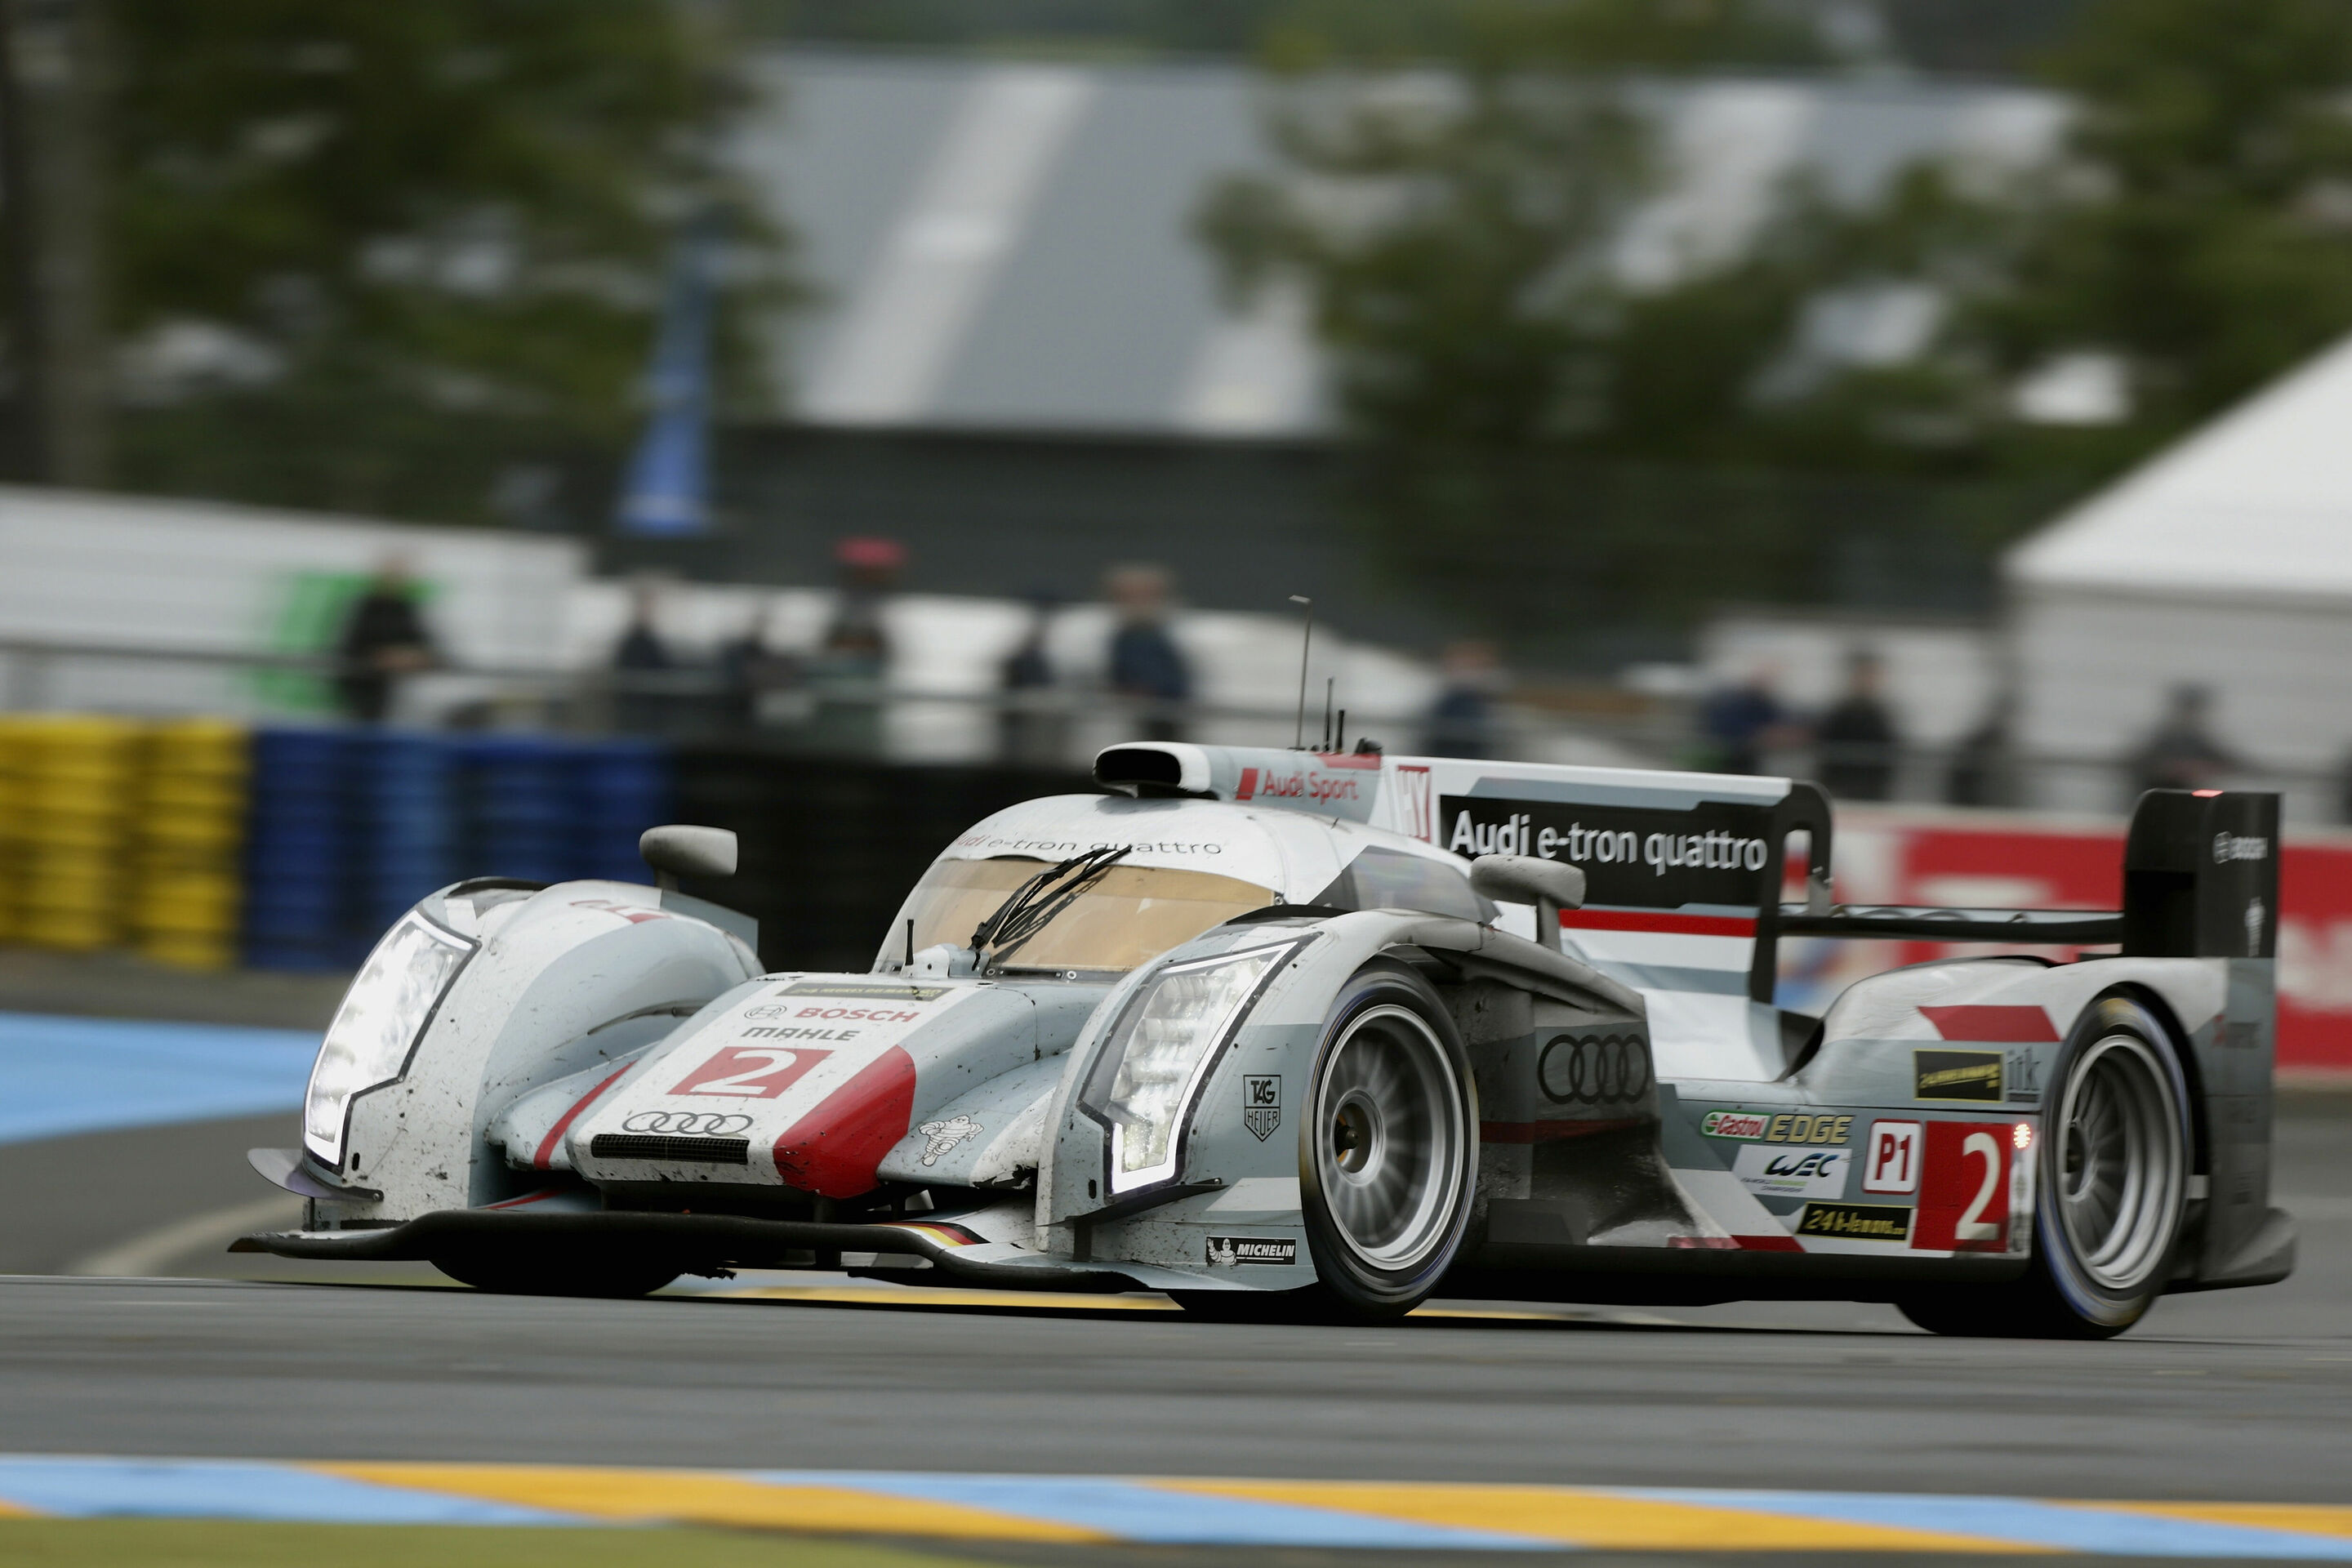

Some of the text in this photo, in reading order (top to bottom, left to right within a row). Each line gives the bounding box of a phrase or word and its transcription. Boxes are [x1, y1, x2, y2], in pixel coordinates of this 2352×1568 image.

[1263, 769, 1359, 805] Audi Sport
[956, 833, 991, 847] udi
[987, 838, 1076, 851] e-tron
[1450, 809, 1768, 876] Audi e-tron quattro
[794, 1007, 921, 1022] BOSCH
[741, 1027, 861, 1041] MAHLE
[689, 1049, 797, 1094] 2
[1250, 1079, 1276, 1104] TAG
[1248, 1111, 1278, 1136] HEUER
[1717, 1113, 1856, 1144] Castrol EDGE
[1764, 1152, 1840, 1178] WEC
[1874, 1133, 1912, 1182] P1
[1954, 1132, 2001, 1241] 2
[1236, 1244, 1295, 1257] MICHELIN
